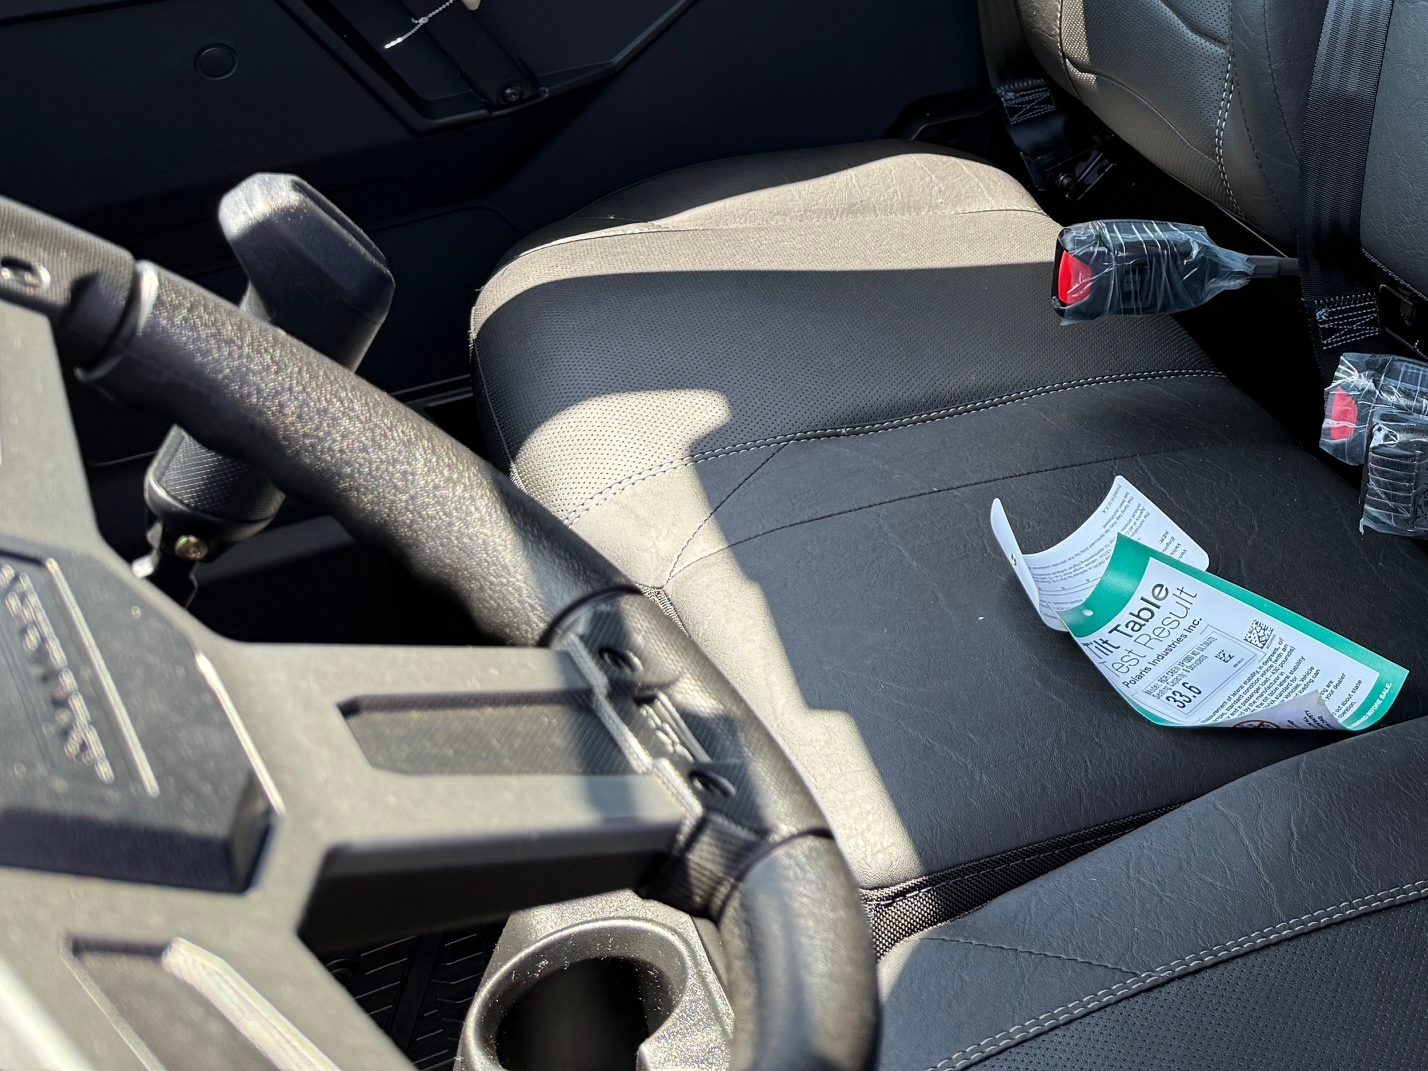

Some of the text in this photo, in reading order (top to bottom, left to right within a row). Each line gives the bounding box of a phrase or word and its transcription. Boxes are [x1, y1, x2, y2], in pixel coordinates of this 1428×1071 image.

[1107, 584, 1169, 637] Table
[1098, 586, 1197, 677] Test Result
[1123, 617, 1202, 689] Polaris Industries Inc.
[1278, 645, 1296, 668] pounds)
[1164, 682, 1201, 708] 33.6
[1333, 673, 1346, 689] dealer
[1365, 698, 1382, 716] BEFORE
[1379, 682, 1392, 699] SALE.
